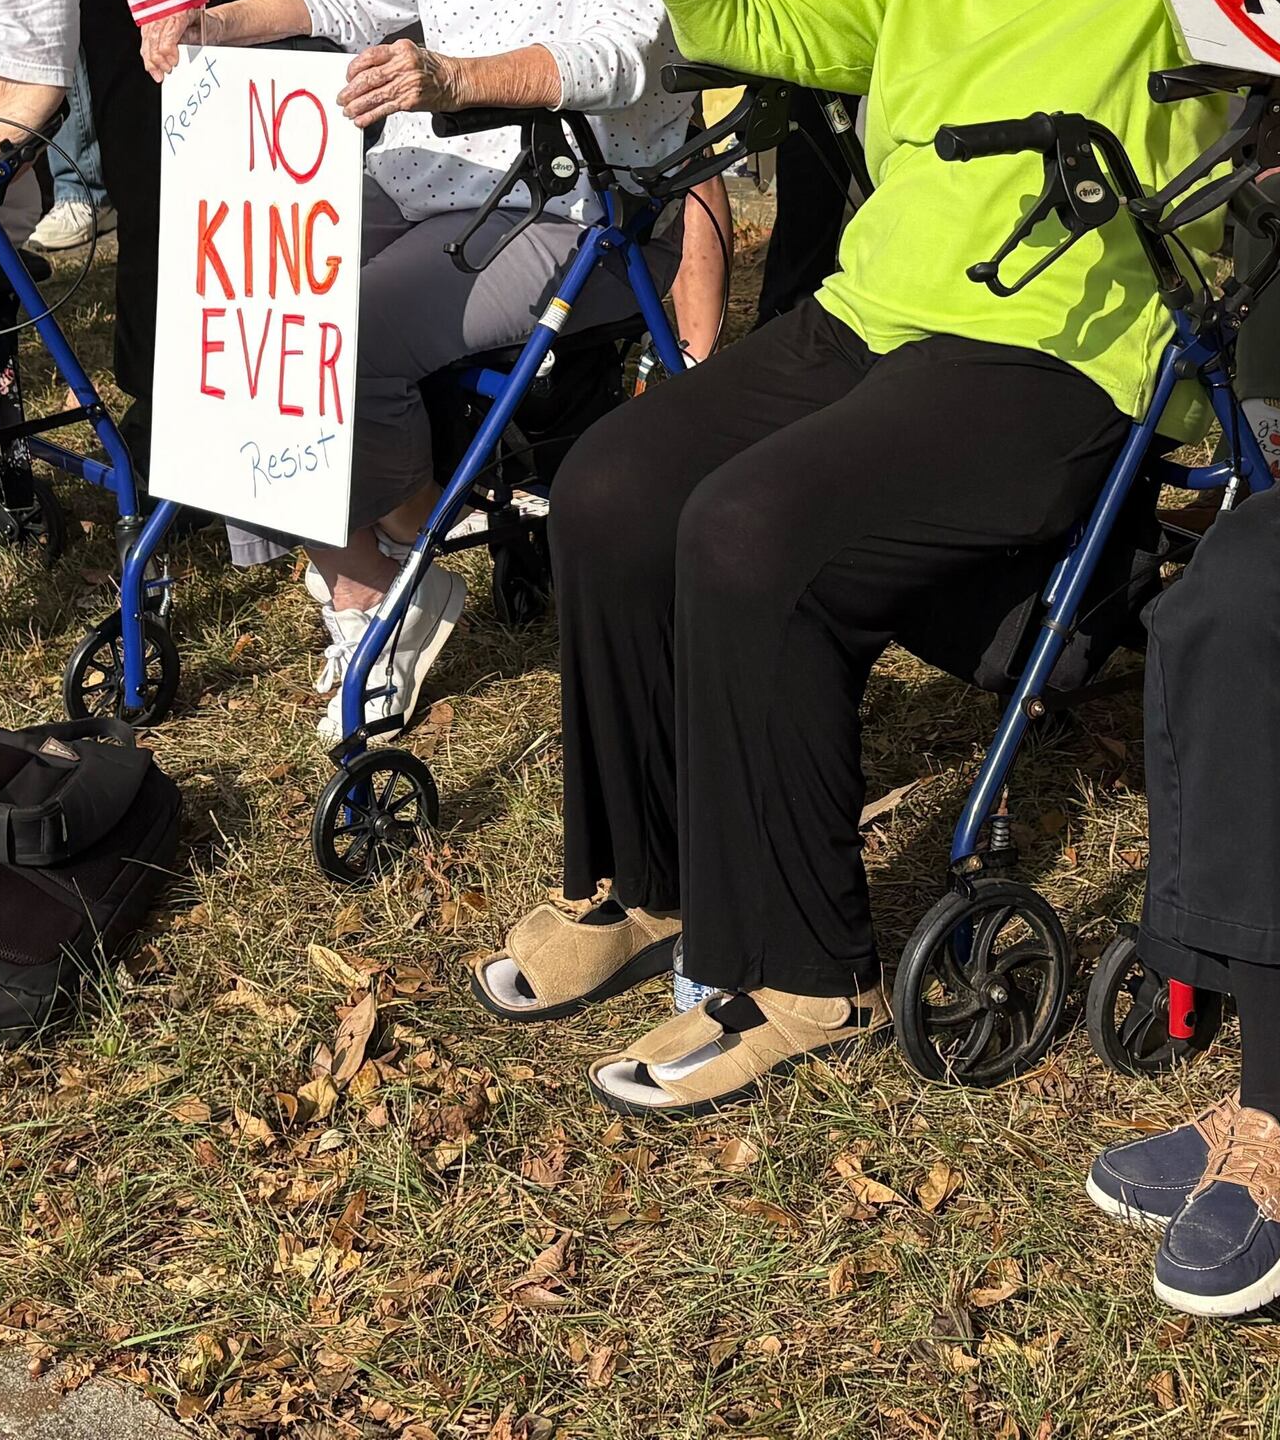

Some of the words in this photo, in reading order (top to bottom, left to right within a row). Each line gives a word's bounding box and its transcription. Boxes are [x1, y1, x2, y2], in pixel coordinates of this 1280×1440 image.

[164, 56, 222, 156] Resist
[249, 78, 329, 184] NO
[195, 199, 343, 300] KING
[200, 307, 344, 425] EVER
[240, 429, 336, 497] Resist
